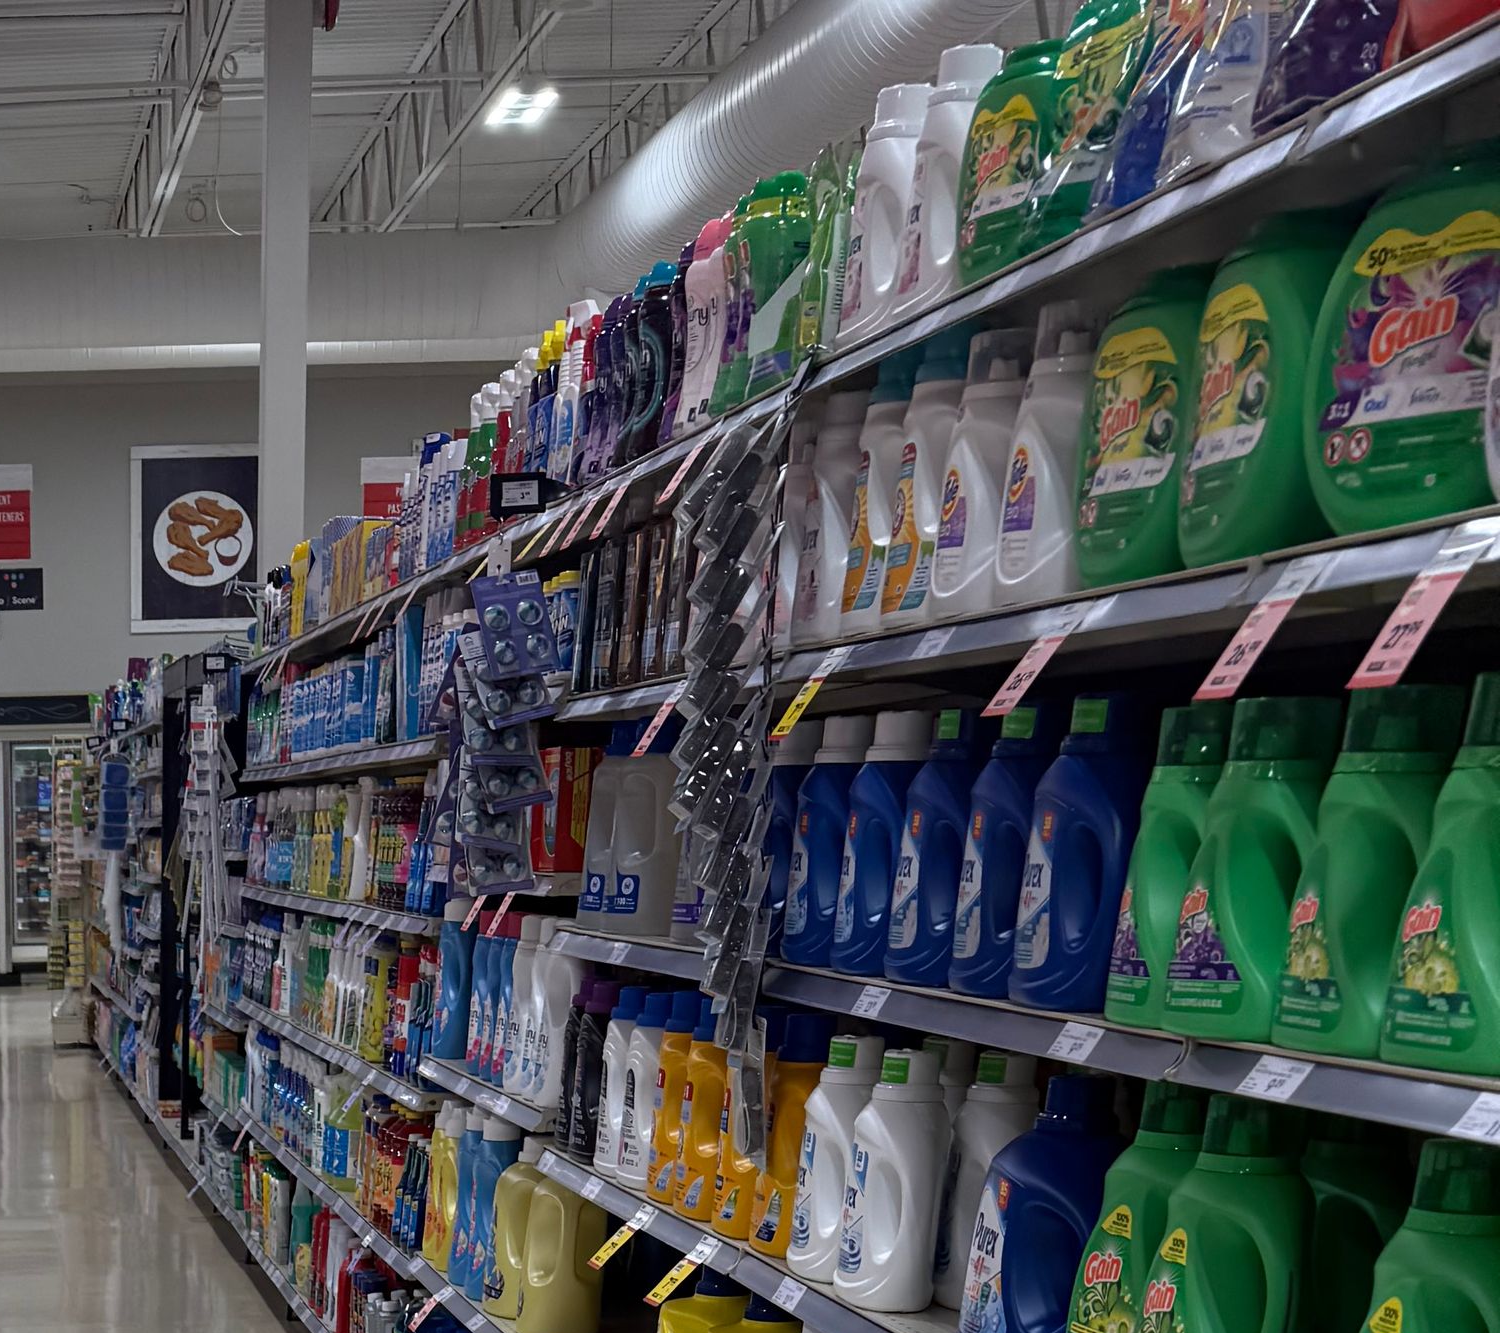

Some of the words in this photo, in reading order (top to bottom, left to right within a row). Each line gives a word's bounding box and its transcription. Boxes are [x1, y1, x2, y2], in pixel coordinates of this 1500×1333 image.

[1369, 295, 1459, 367] Gain
[975, 1211, 998, 1259] Purex
[1084, 1251, 1123, 1287] Gain
[1144, 1280, 1177, 1318] Gain
